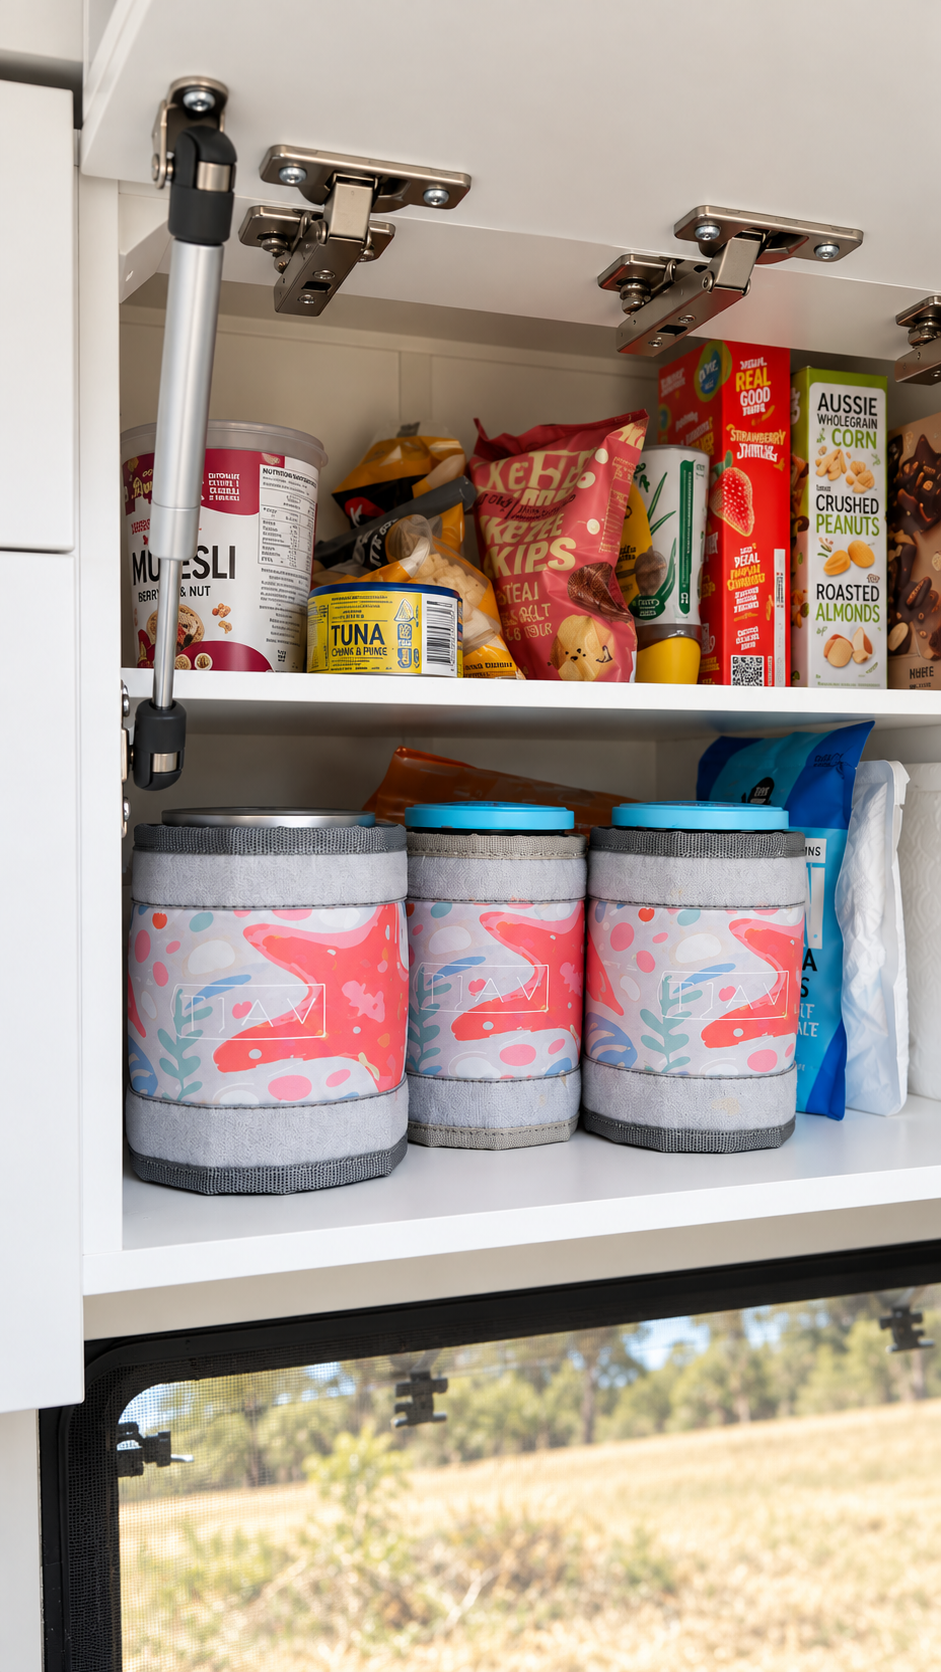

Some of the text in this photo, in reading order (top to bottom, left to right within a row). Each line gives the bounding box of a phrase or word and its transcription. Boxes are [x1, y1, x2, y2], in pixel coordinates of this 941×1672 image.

[735, 367, 771, 392] REAL
[740, 386, 771, 407] GOOD
[817, 392, 878, 417] AUSSIE
[817, 413, 878, 430] WHOLEGRAIN
[831, 428, 877, 450] CORN
[815, 494, 880, 515] CRUSHED
[815, 513, 880, 537] PEANUTS
[138, 588, 160, 603] BERR
[189, 585, 212, 598] NUT
[816, 583, 880, 602] ROASTED
[815, 602, 881, 623] ALMONDS
[331, 623, 386, 647] TUNA
